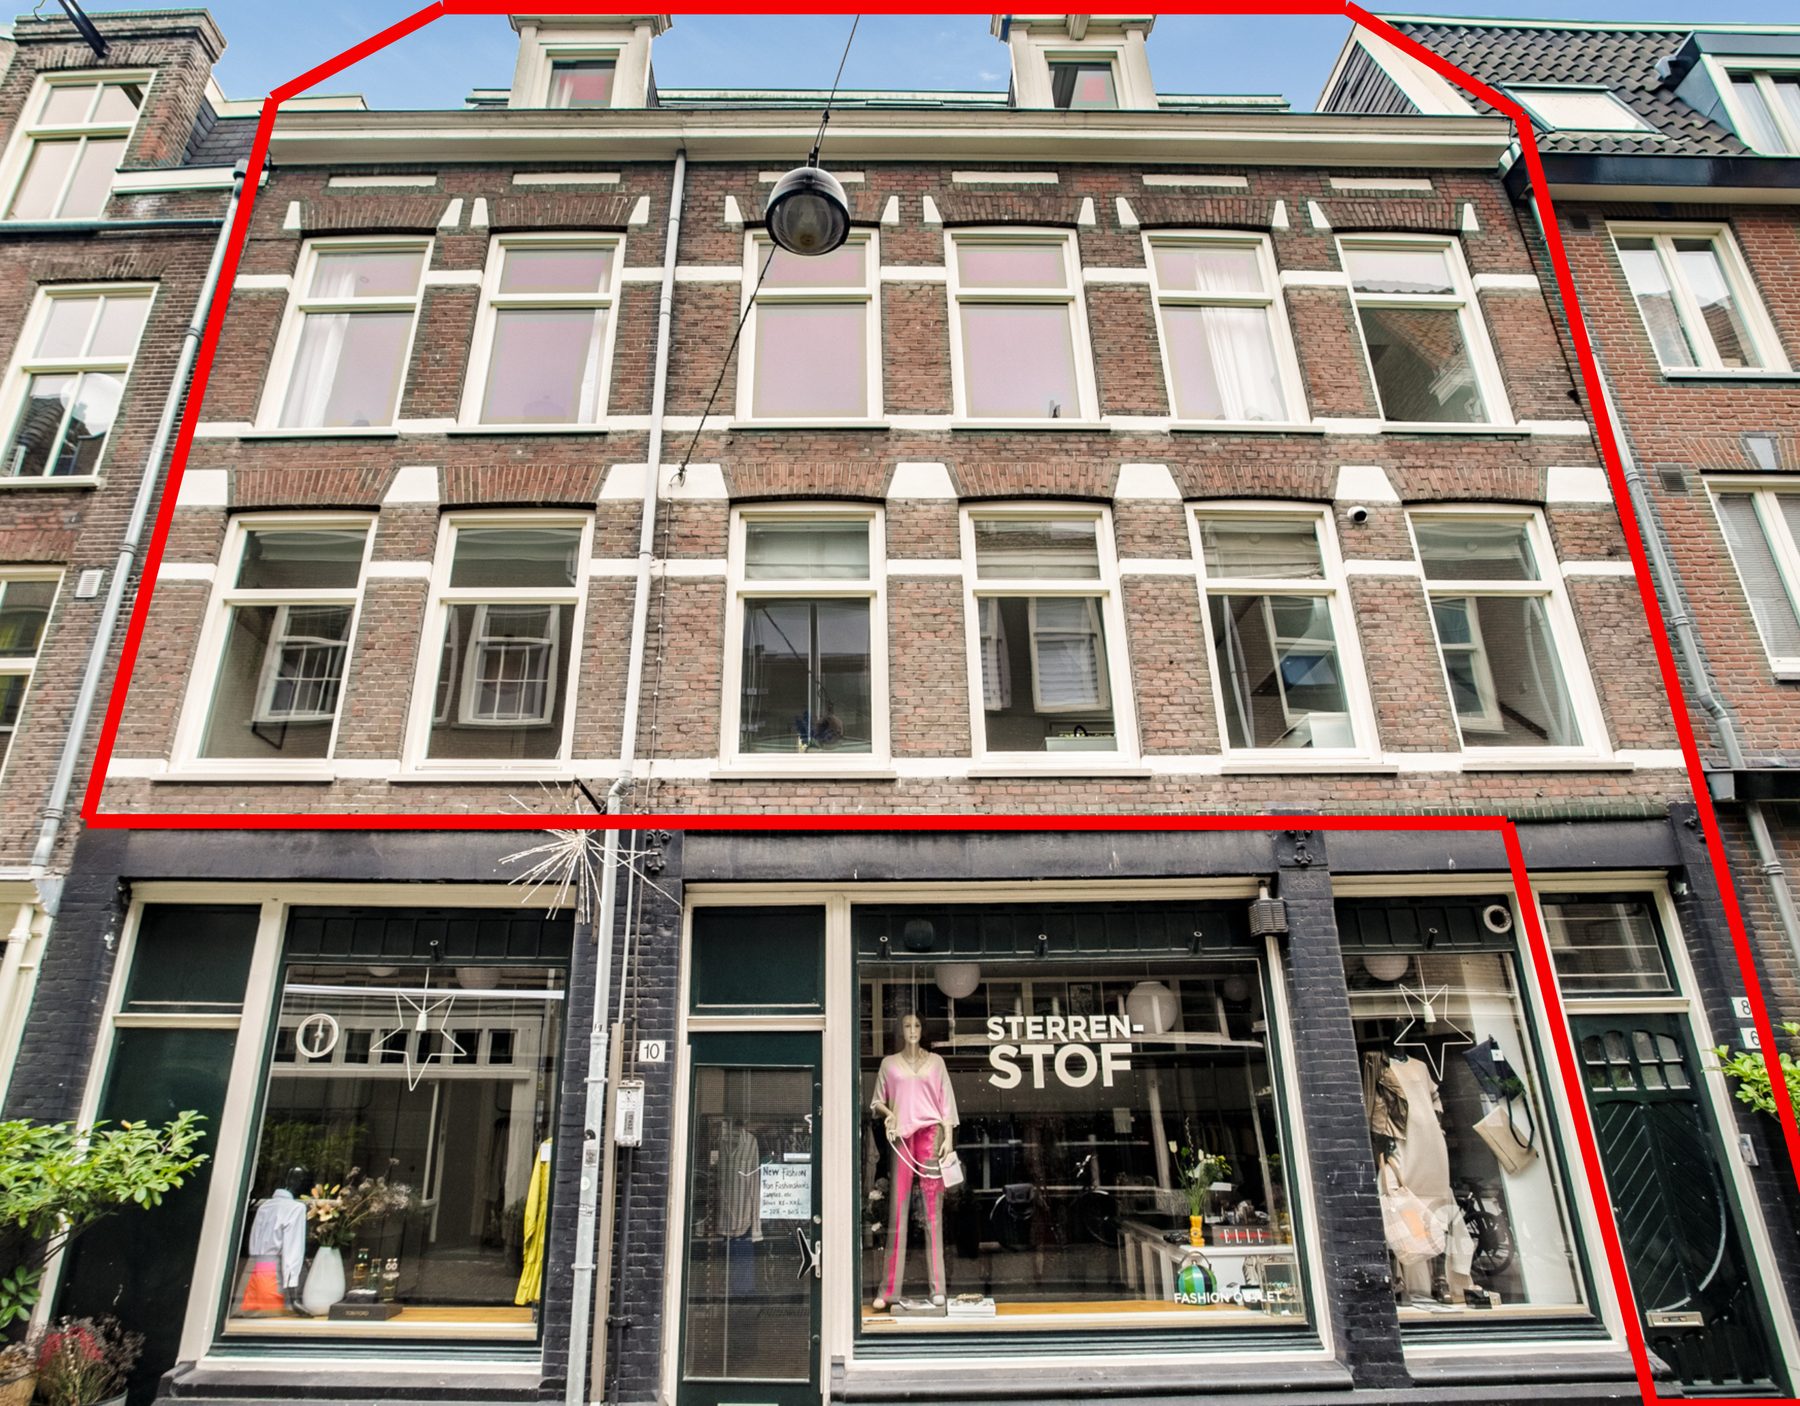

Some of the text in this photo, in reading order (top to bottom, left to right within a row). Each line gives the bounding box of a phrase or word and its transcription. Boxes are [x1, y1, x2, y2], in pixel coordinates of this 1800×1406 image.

[1741, 1000, 1751, 1015] 8
[987, 1015, 1144, 1042] STERREN-
[1751, 1030, 1760, 1046] 6
[643, 1043, 660, 1059] 10
[988, 1043, 1132, 1089] STOF
[1223, 1228, 1265, 1244] ELLE
[1174, 1290, 1283, 1304] FASHION OULET
